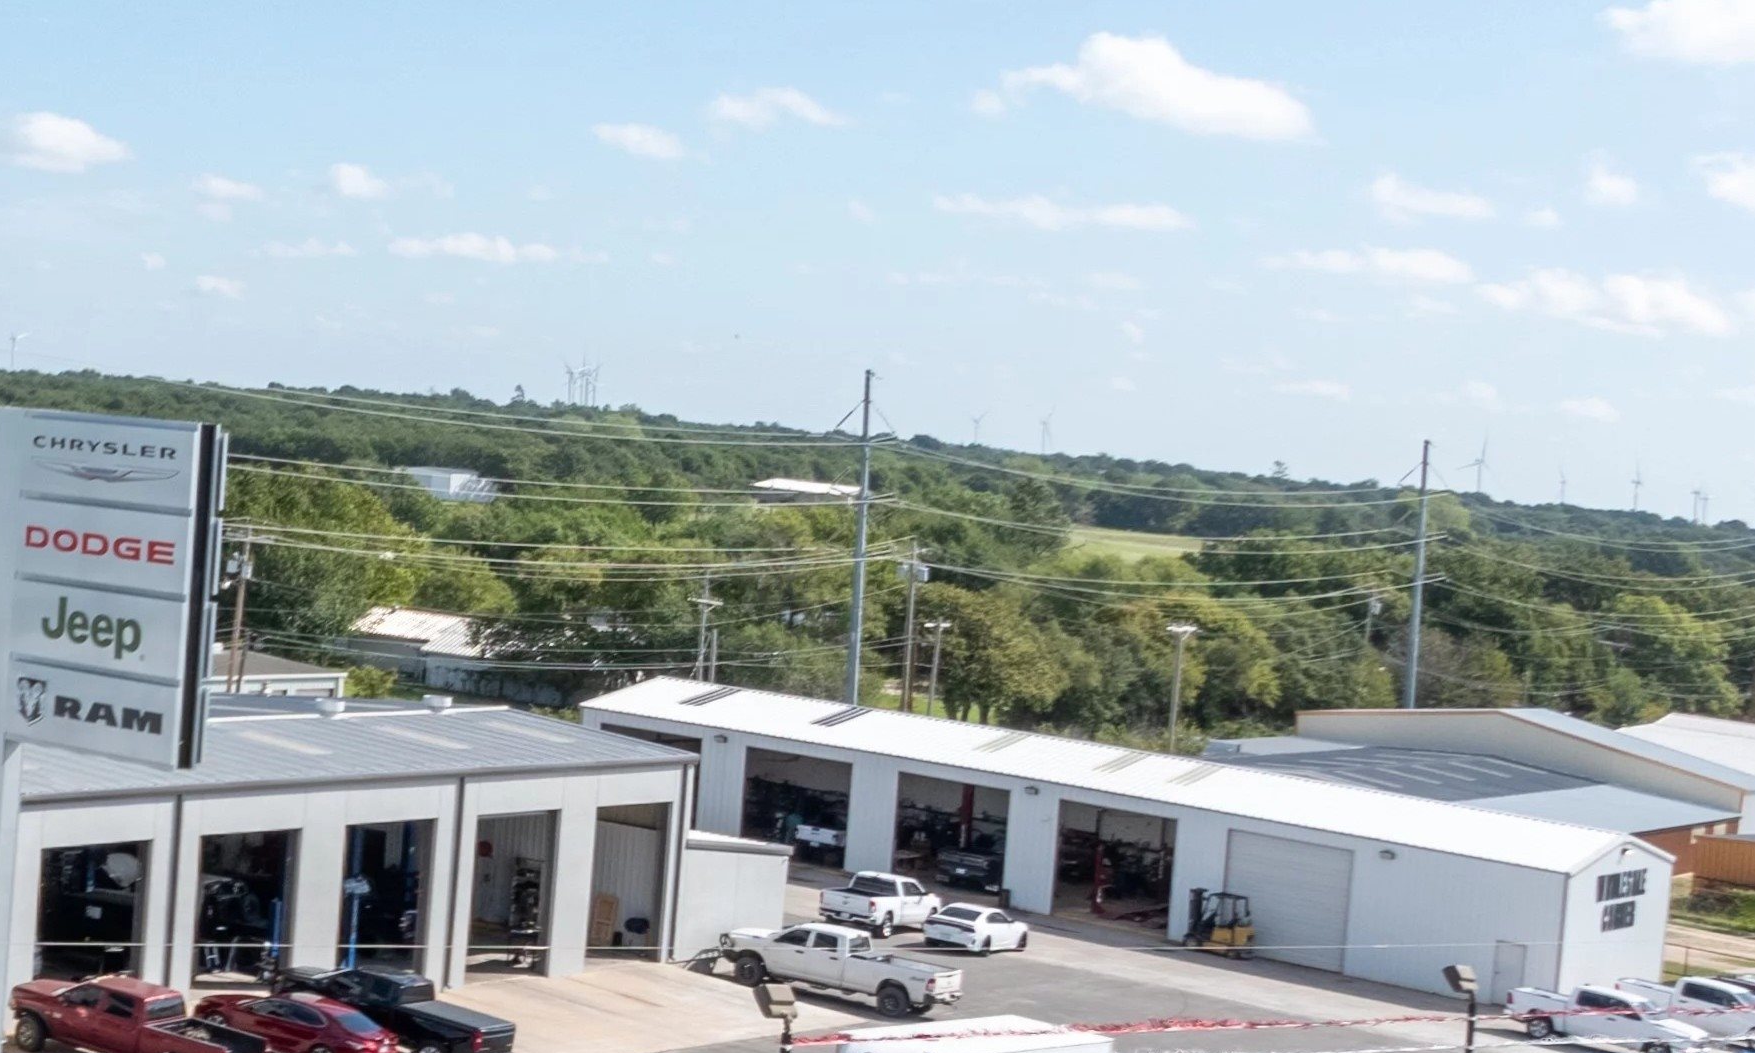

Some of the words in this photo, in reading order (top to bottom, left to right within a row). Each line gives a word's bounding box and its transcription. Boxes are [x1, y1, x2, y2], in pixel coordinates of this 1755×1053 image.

[33, 435, 178, 460] CHRYSLER
[25, 525, 176, 566] DODGE
[41, 596, 142, 660] Jeep
[53, 694, 164, 735] RAM
